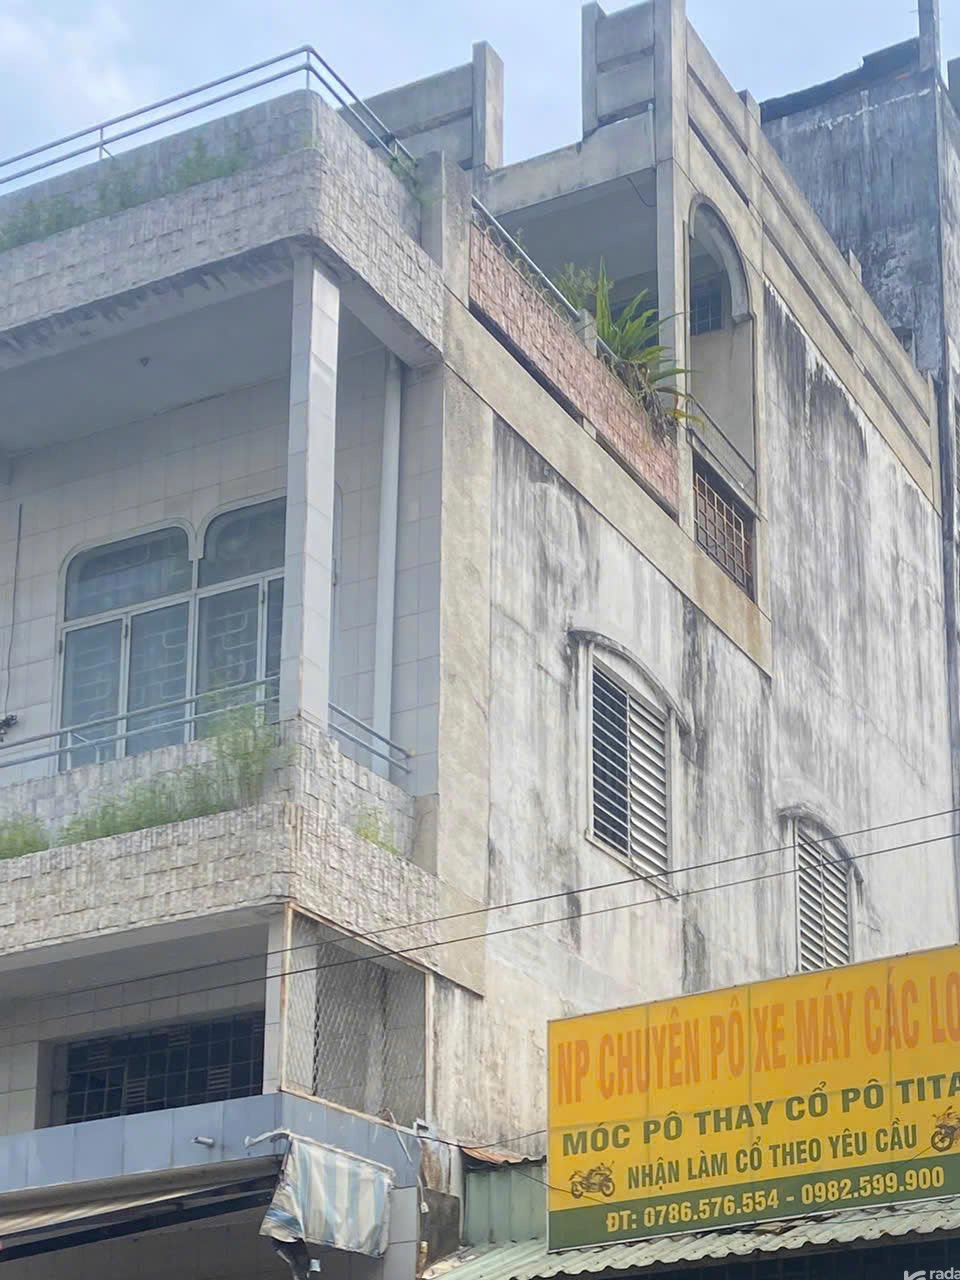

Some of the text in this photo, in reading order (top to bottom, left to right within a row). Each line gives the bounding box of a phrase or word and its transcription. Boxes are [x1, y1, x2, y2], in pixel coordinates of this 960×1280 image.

[557, 1040, 590, 1105] NP
[599, 1006, 701, 1100] CHUYÊN
[710, 995, 745, 1080] PÔ
[753, 1003, 786, 1073] XE
[796, 977, 852, 1065] MÁY
[864, 966, 920, 1056] CÁC
[562, 1121, 631, 1157] MÓC
[643, 1110, 683, 1144] PÔ
[694, 1099, 774, 1136] THAY
[785, 1080, 829, 1121] CỔ
[841, 1078, 884, 1113] PÔ
[628, 1117, 917, 1190] NHẬN LÀM CỔ THEO YÊU CẦU
[606, 1209, 637, 1232] ĐT:
[643, 1188, 780, 1228] 0786.576.554
[801, 1166, 945, 1205] 0982.599.900
